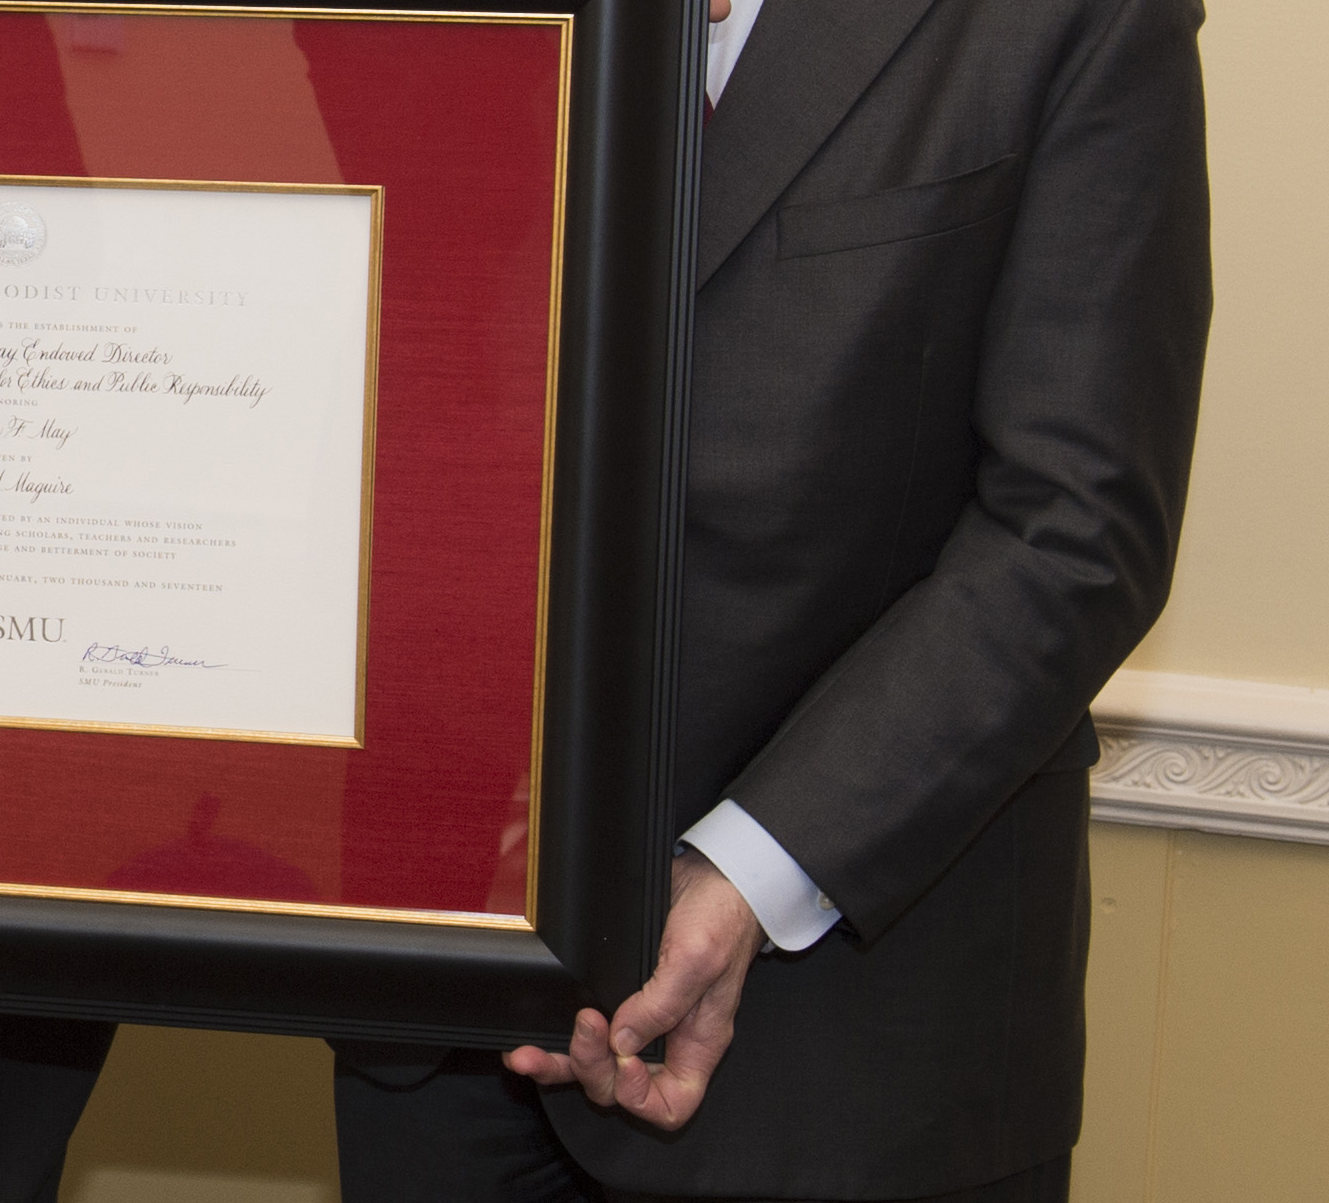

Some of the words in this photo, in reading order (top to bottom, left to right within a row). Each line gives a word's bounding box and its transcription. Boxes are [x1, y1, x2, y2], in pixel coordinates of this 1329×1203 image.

[93, 287, 249, 307] UNIVERSITY
[9, 322, 29, 330] THE
[34, 323, 119, 333] ESTABLISHMENT
[22, 337, 99, 365] Endowed
[102, 341, 173, 365] Director
[17, 366, 69, 394] Ethics
[73, 376, 106, 391] and
[107, 371, 159, 394] Public
[162, 372, 273, 409] Responsibility
[29, 418, 78, 450] May
[6, 471, 74, 503] Maguire
[21, 515, 32, 523] BY
[56, 517, 119, 527] INDIVIDUAL
[125, 520, 161, 529] WHOSE
[166, 522, 203, 530] VISION
[16, 530, 74, 540] SCHOLARS,
[79, 533, 131, 542] TEACHERS
[137, 536, 158, 544] AND
[163, 537, 237, 547] RESEARCHERS
[14, 545, 36, 553] AND
[41, 547, 109, 556] BETTERMENT
[133, 550, 177, 560] SOCIETY
[43, 576, 65, 584] TWO
[71, 577, 129, 587] THOUSAND
[134, 581, 156, 589] AND
[161, 582, 223, 592] SEVENTEEN
